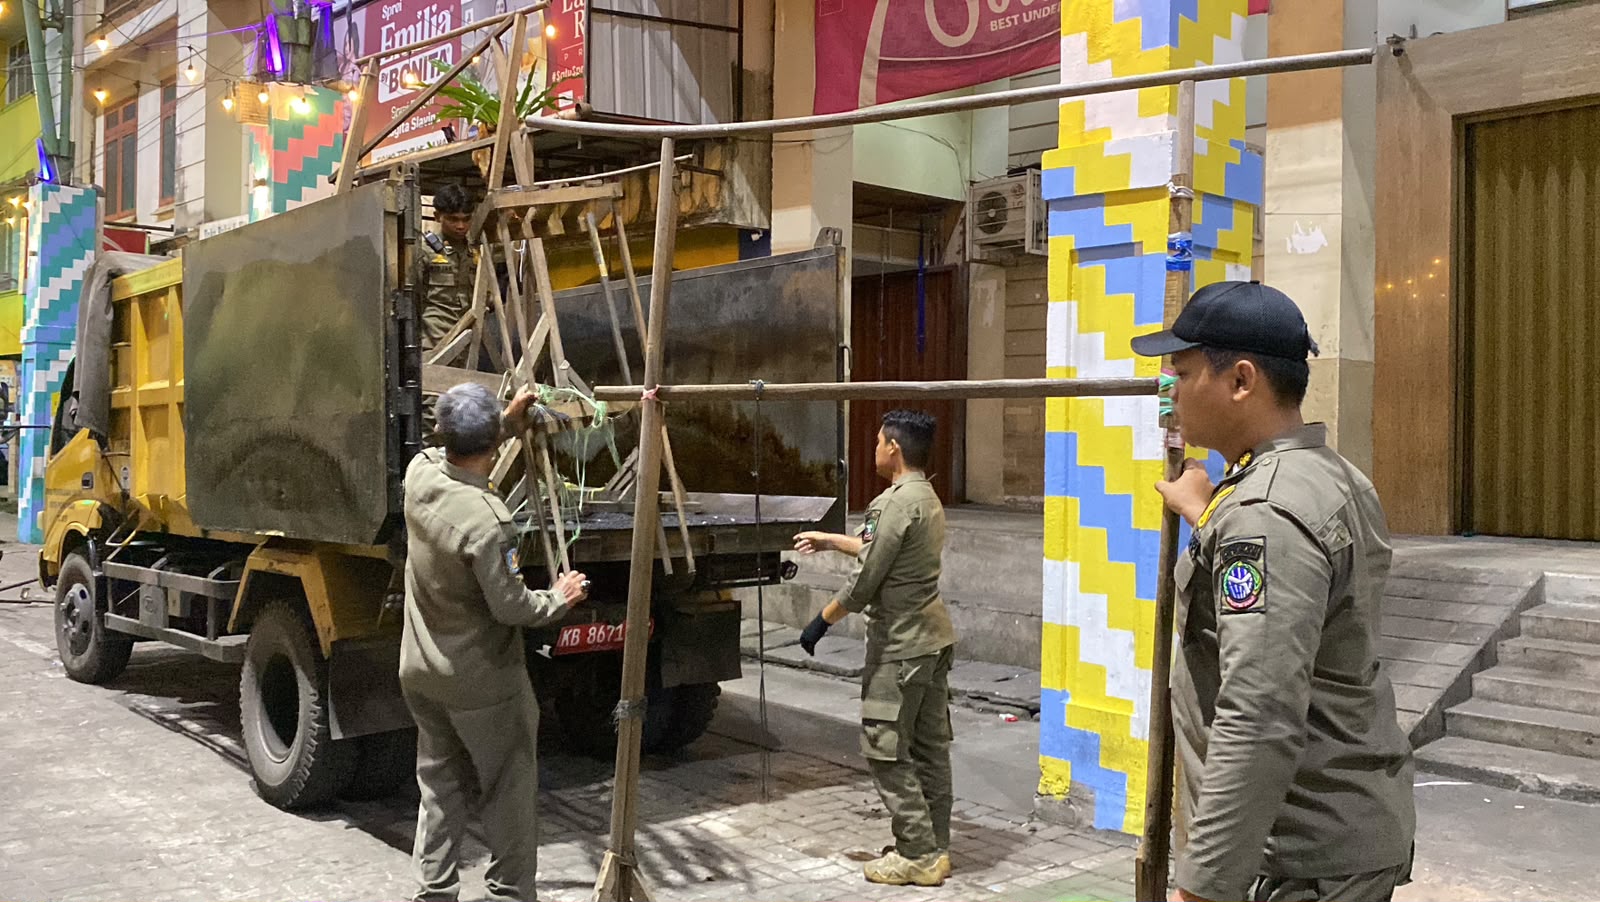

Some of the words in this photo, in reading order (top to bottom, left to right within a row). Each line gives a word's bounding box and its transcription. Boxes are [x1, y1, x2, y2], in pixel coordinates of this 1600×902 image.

[381, 0, 402, 21] Sprei
[990, 14, 1019, 32] BEST
[380, 4, 451, 66] Emilia
[381, 72, 388, 83] BY
[389, 49, 448, 93] BONITA
[561, 628, 581, 647] KB
[586, 624, 624, 645] 8671
